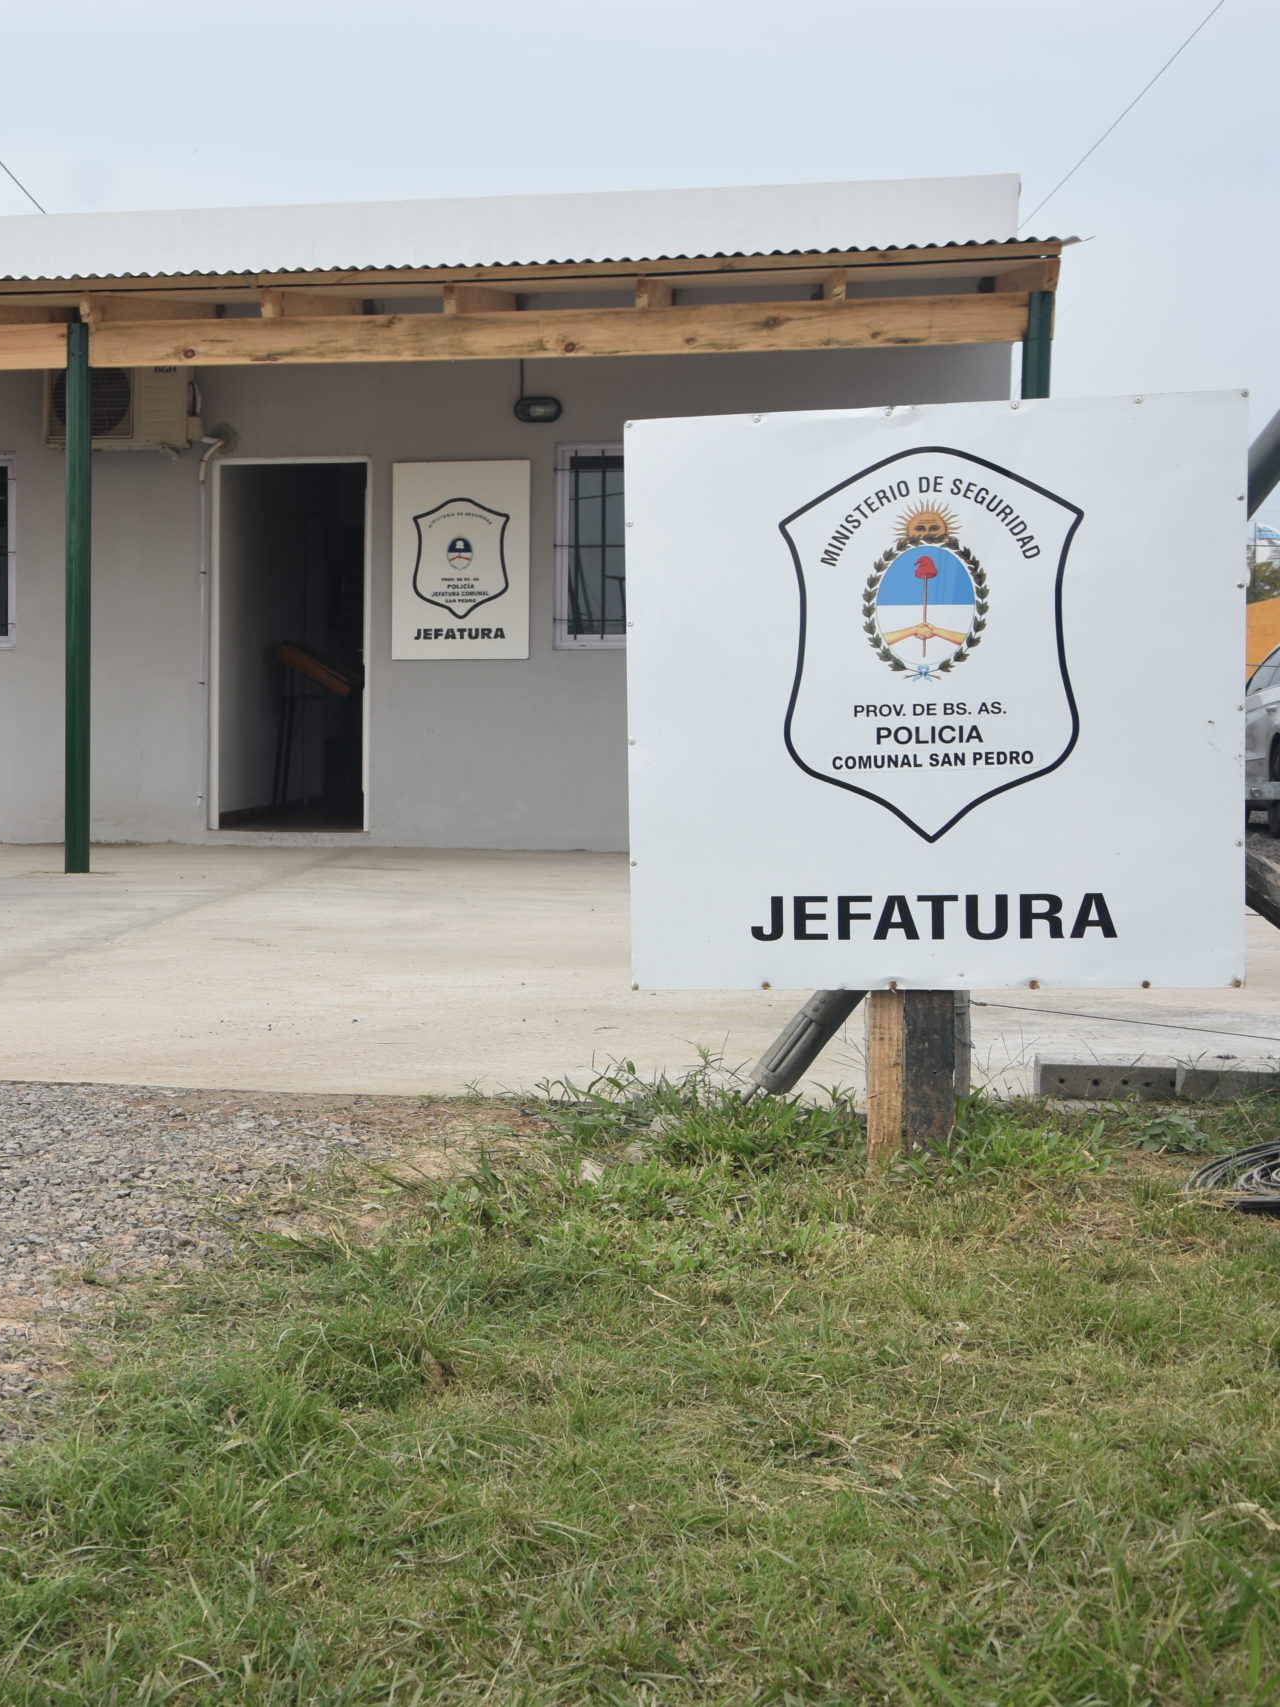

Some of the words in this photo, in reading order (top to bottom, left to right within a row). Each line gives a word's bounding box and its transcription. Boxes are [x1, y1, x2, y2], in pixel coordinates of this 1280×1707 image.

[819, 480, 911, 568] MINISTERIO
[918, 475, 944, 494] DE
[950, 478, 1042, 561] SEGURIDAD
[414, 627, 506, 640] JEFATURA
[853, 703, 907, 718] PROV.
[912, 702, 938, 717] DE
[943, 702, 972, 716] BS.
[977, 701, 1007, 715] AS.
[875, 724, 984, 745] POLICIA
[831, 754, 923, 770] COMUNAL
[929, 752, 966, 767] SAN
[972, 750, 1034, 766] PEDRO
[750, 892, 1119, 942] JEFATURA
